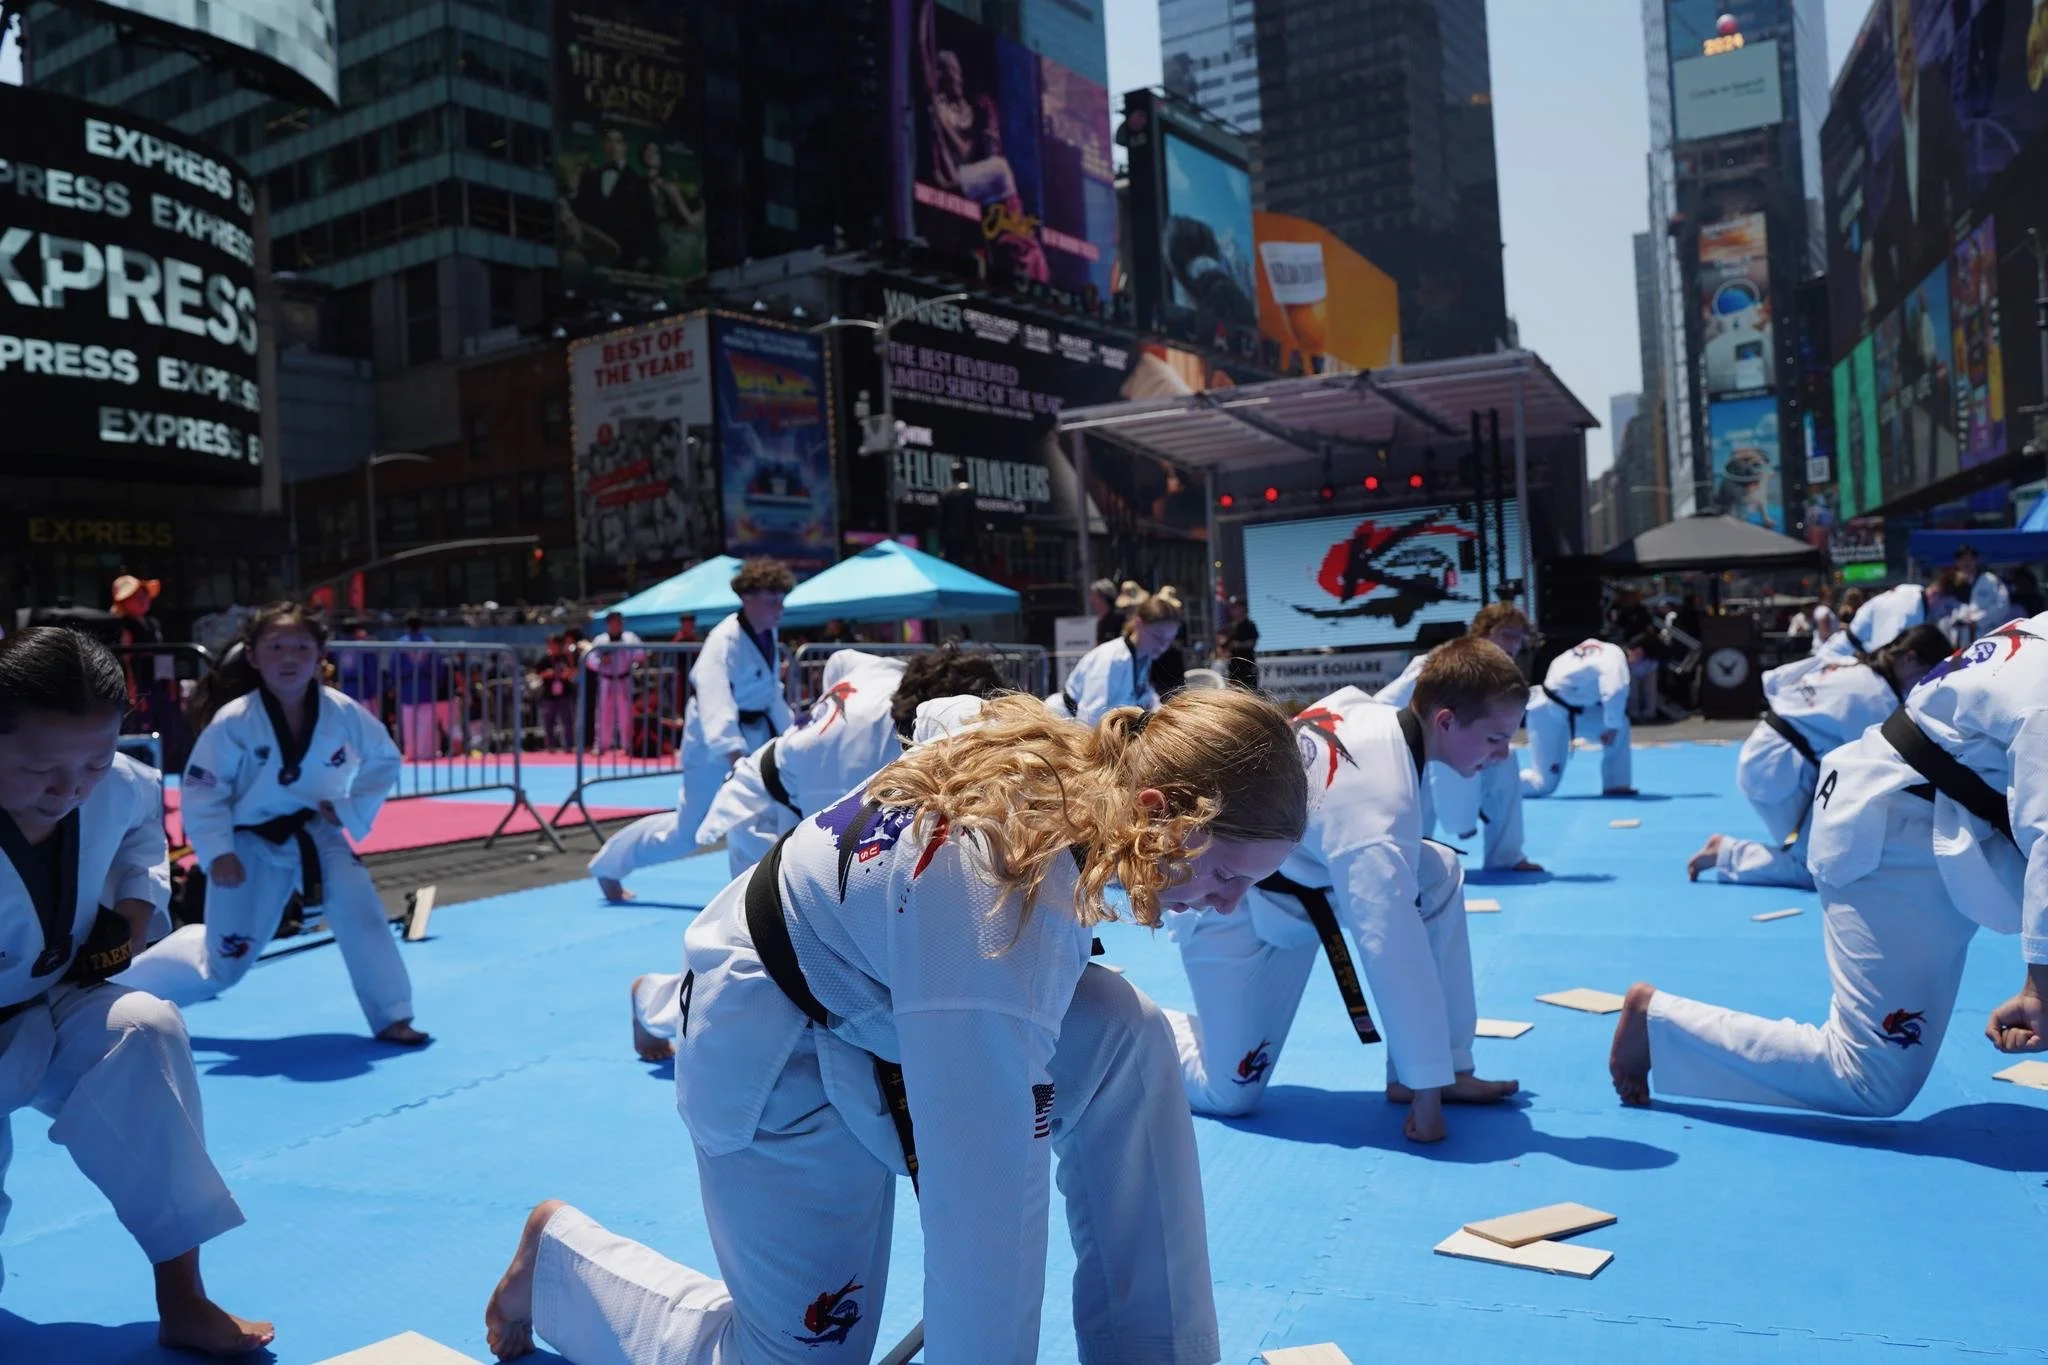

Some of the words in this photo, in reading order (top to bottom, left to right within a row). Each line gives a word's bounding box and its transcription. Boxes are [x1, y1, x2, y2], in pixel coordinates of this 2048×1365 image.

[85, 117, 233, 199] EXPRESS
[602, 334, 654, 365] BEST
[658, 326, 686, 351] OF
[594, 363, 632, 388] THE
[636, 349, 695, 380] YEAR!
[99, 405, 243, 460] EXPRESS
[28, 516, 173, 548] EXPRESS
